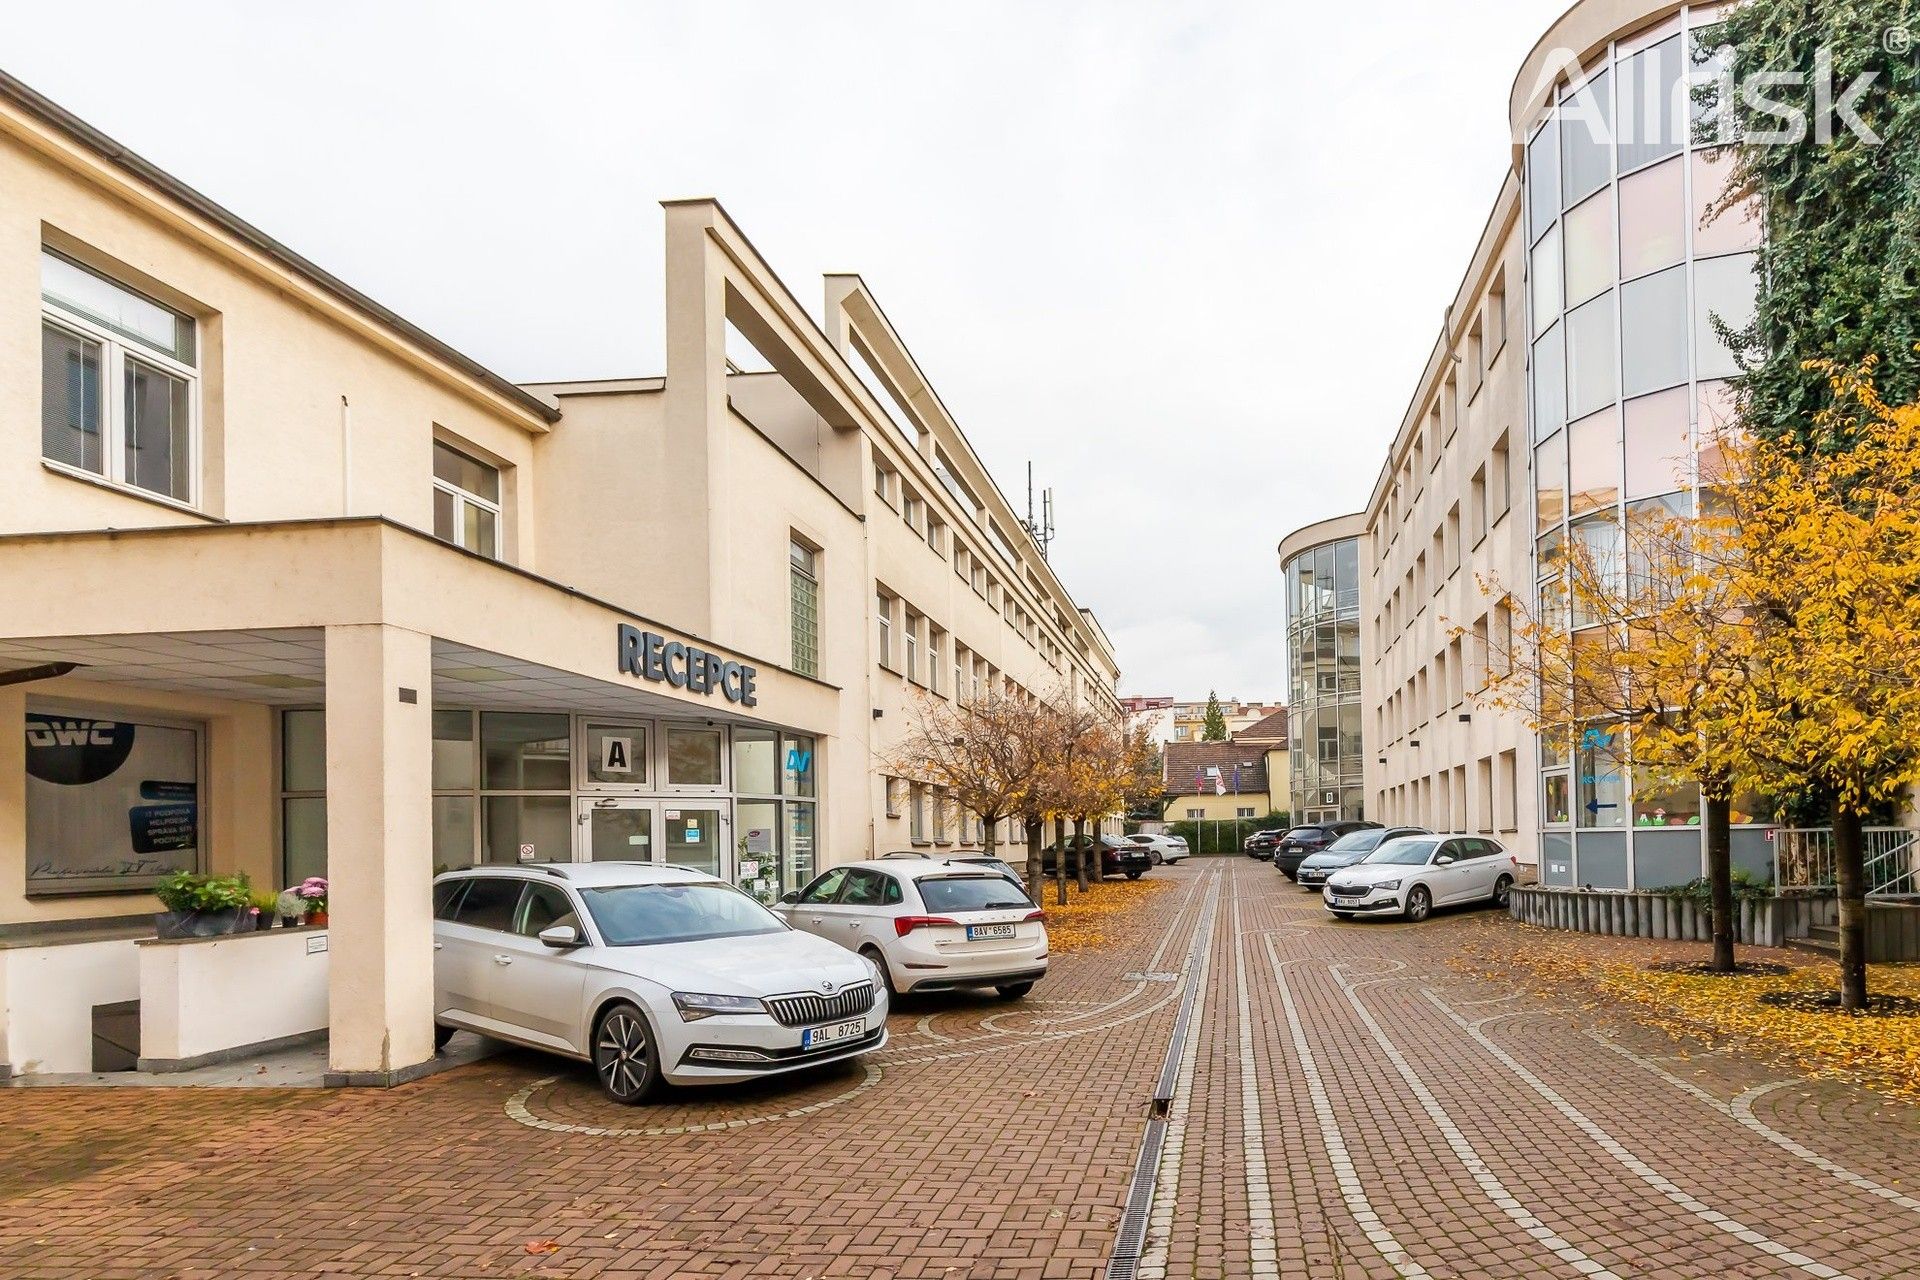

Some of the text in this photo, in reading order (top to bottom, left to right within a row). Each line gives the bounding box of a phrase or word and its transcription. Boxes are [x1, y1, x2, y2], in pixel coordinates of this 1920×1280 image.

[617, 622, 757, 707] RECEPCE
[607, 740, 627, 768] A
[973, 925, 1012, 936] 8AV 6585
[812, 1021, 861, 1042] 9AL 8725
